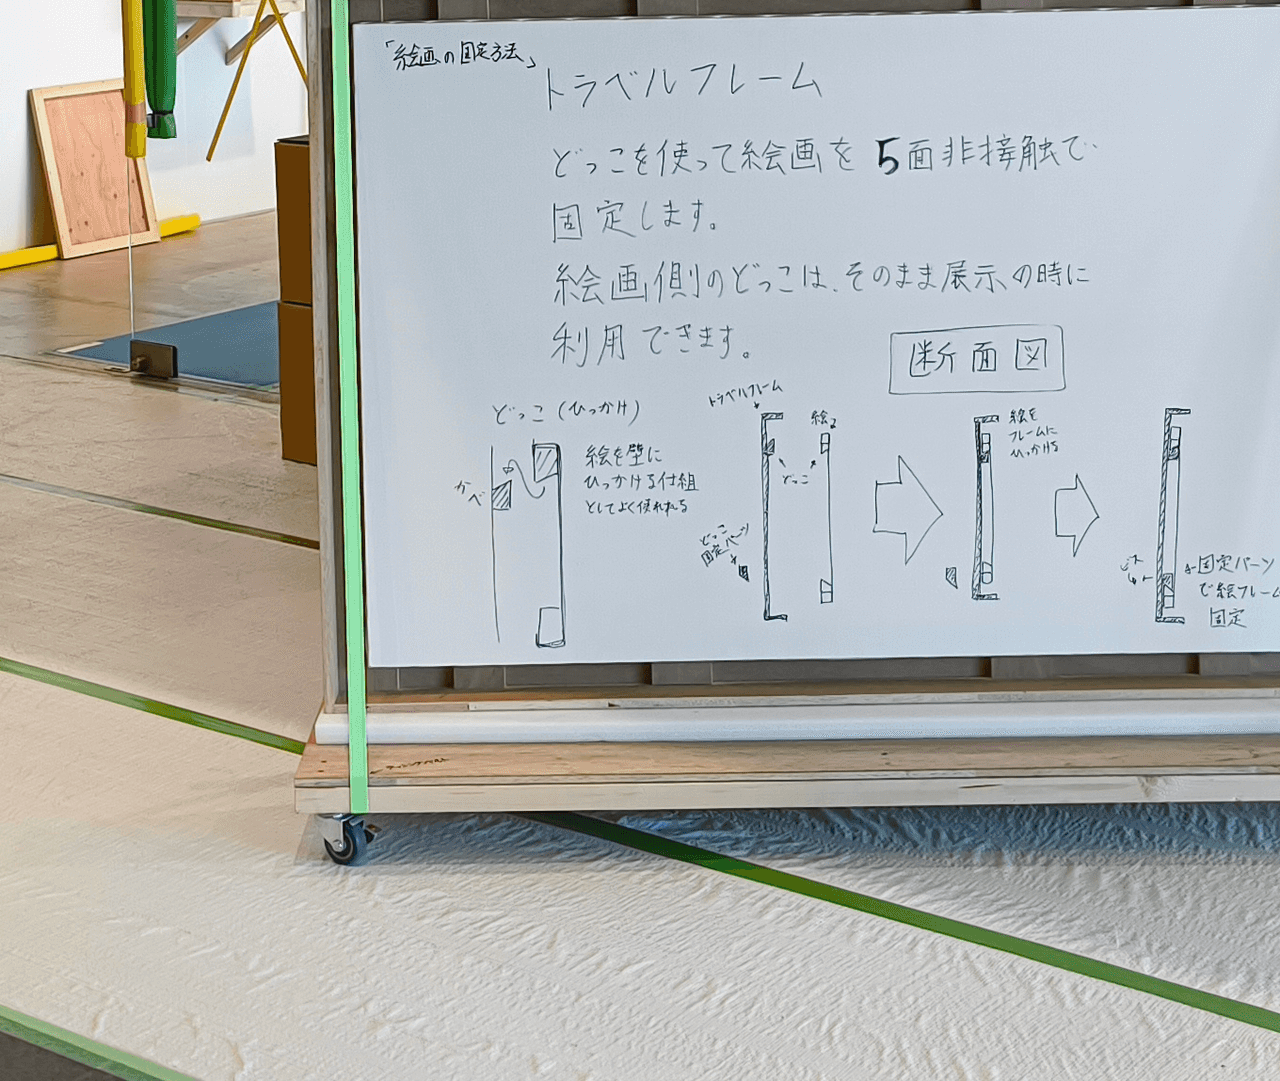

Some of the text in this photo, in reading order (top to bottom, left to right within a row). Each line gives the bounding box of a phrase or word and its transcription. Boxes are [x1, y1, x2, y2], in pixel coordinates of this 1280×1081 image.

[545, 59, 824, 111] トラベルフレーム
[551, 197, 719, 244] 固定します。
[549, 319, 754, 369] 利用できます。
[908, 338, 1049, 378] 断面図
[707, 378, 784, 408] トラベルフレーム
[585, 443, 663, 469] 絵を壁に
[583, 471, 700, 493] ひっかける仕組
[1209, 607, 1248, 629] 固定
